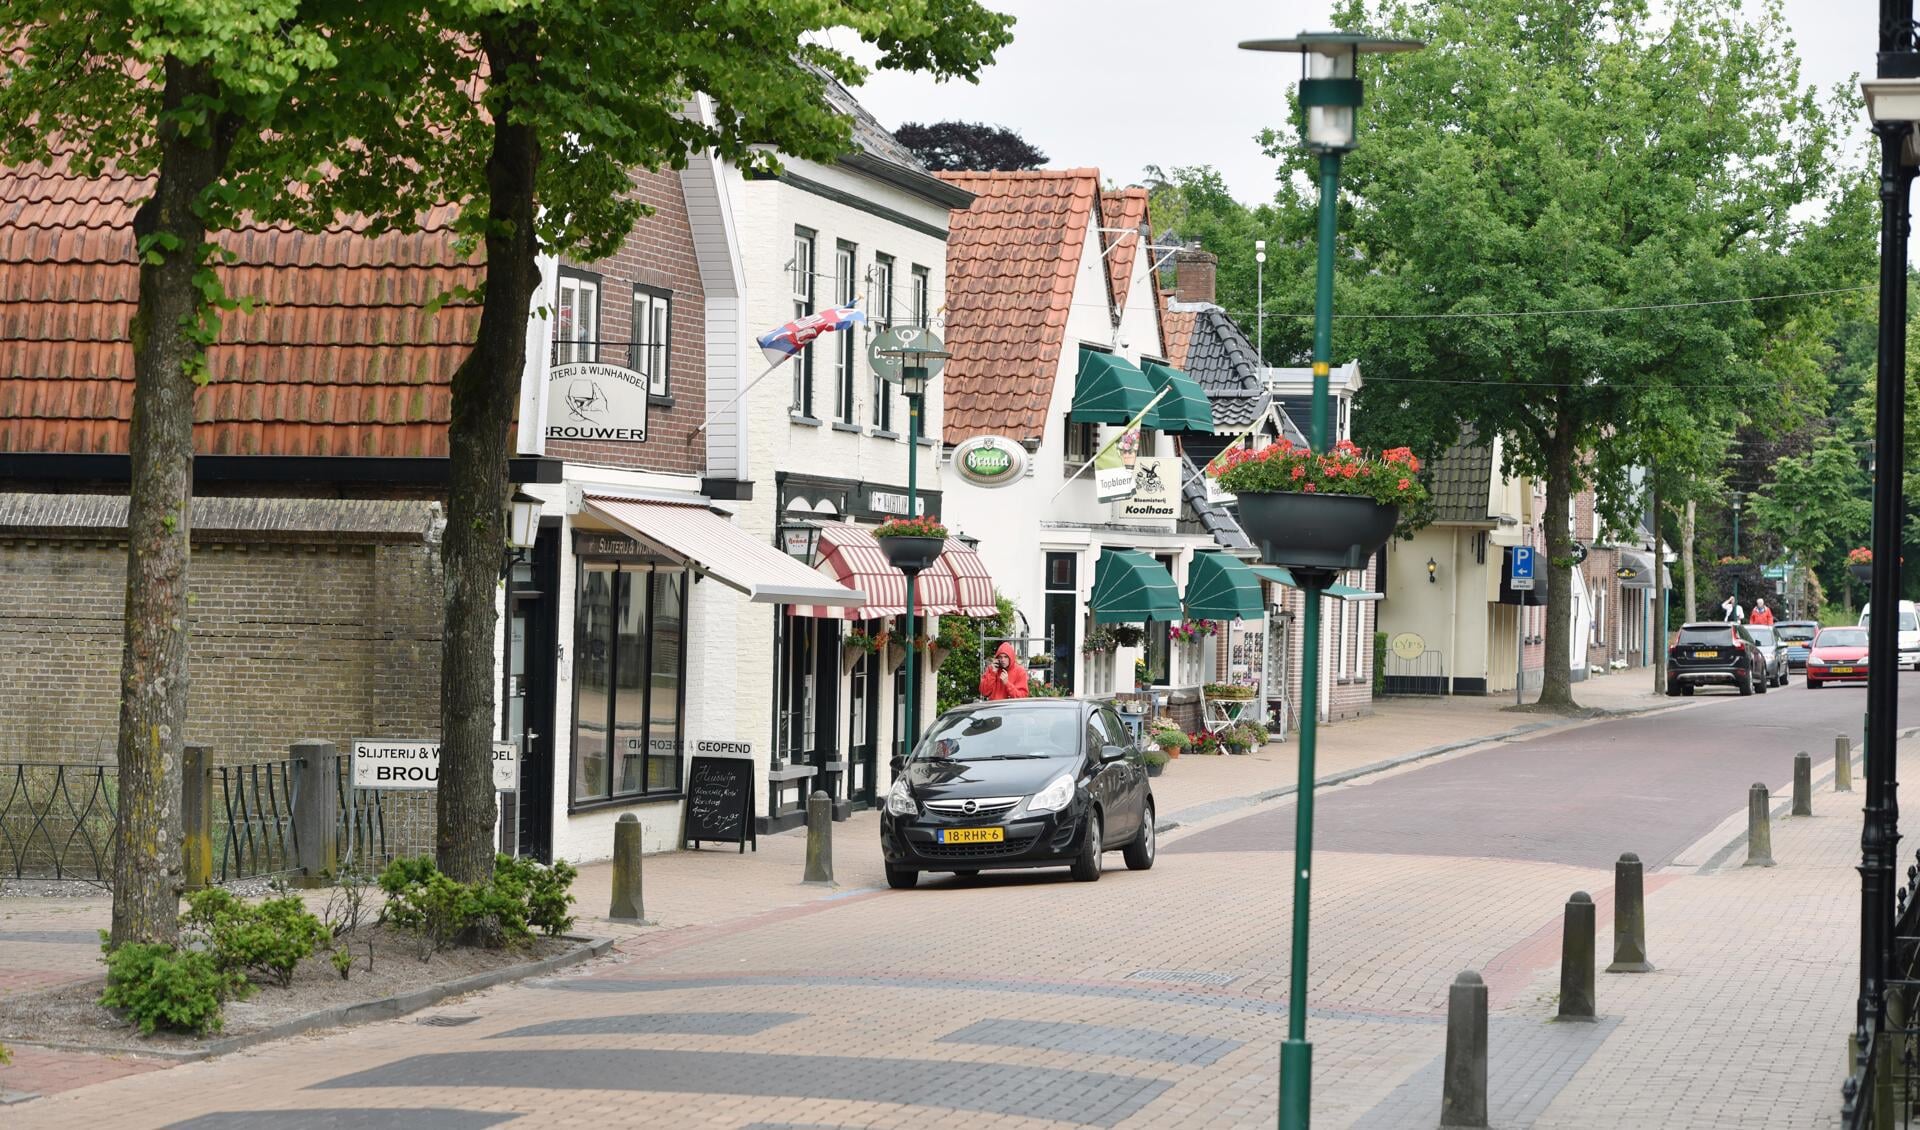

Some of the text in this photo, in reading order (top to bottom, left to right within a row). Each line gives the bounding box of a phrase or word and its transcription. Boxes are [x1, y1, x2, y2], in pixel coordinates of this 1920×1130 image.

[581, 366, 587, 375] &
[589, 366, 646, 391] WIJNHANDEL
[968, 451, 1009, 469] Brand
[1125, 505, 1174, 515] Koolhaas
[1517, 549, 1529, 566] P
[357, 746, 416, 759] SLIJTERIJ
[418, 748, 429, 759] &
[697, 741, 751, 754] GEOPEND
[948, 829, 999, 841] 18-RHR-6
